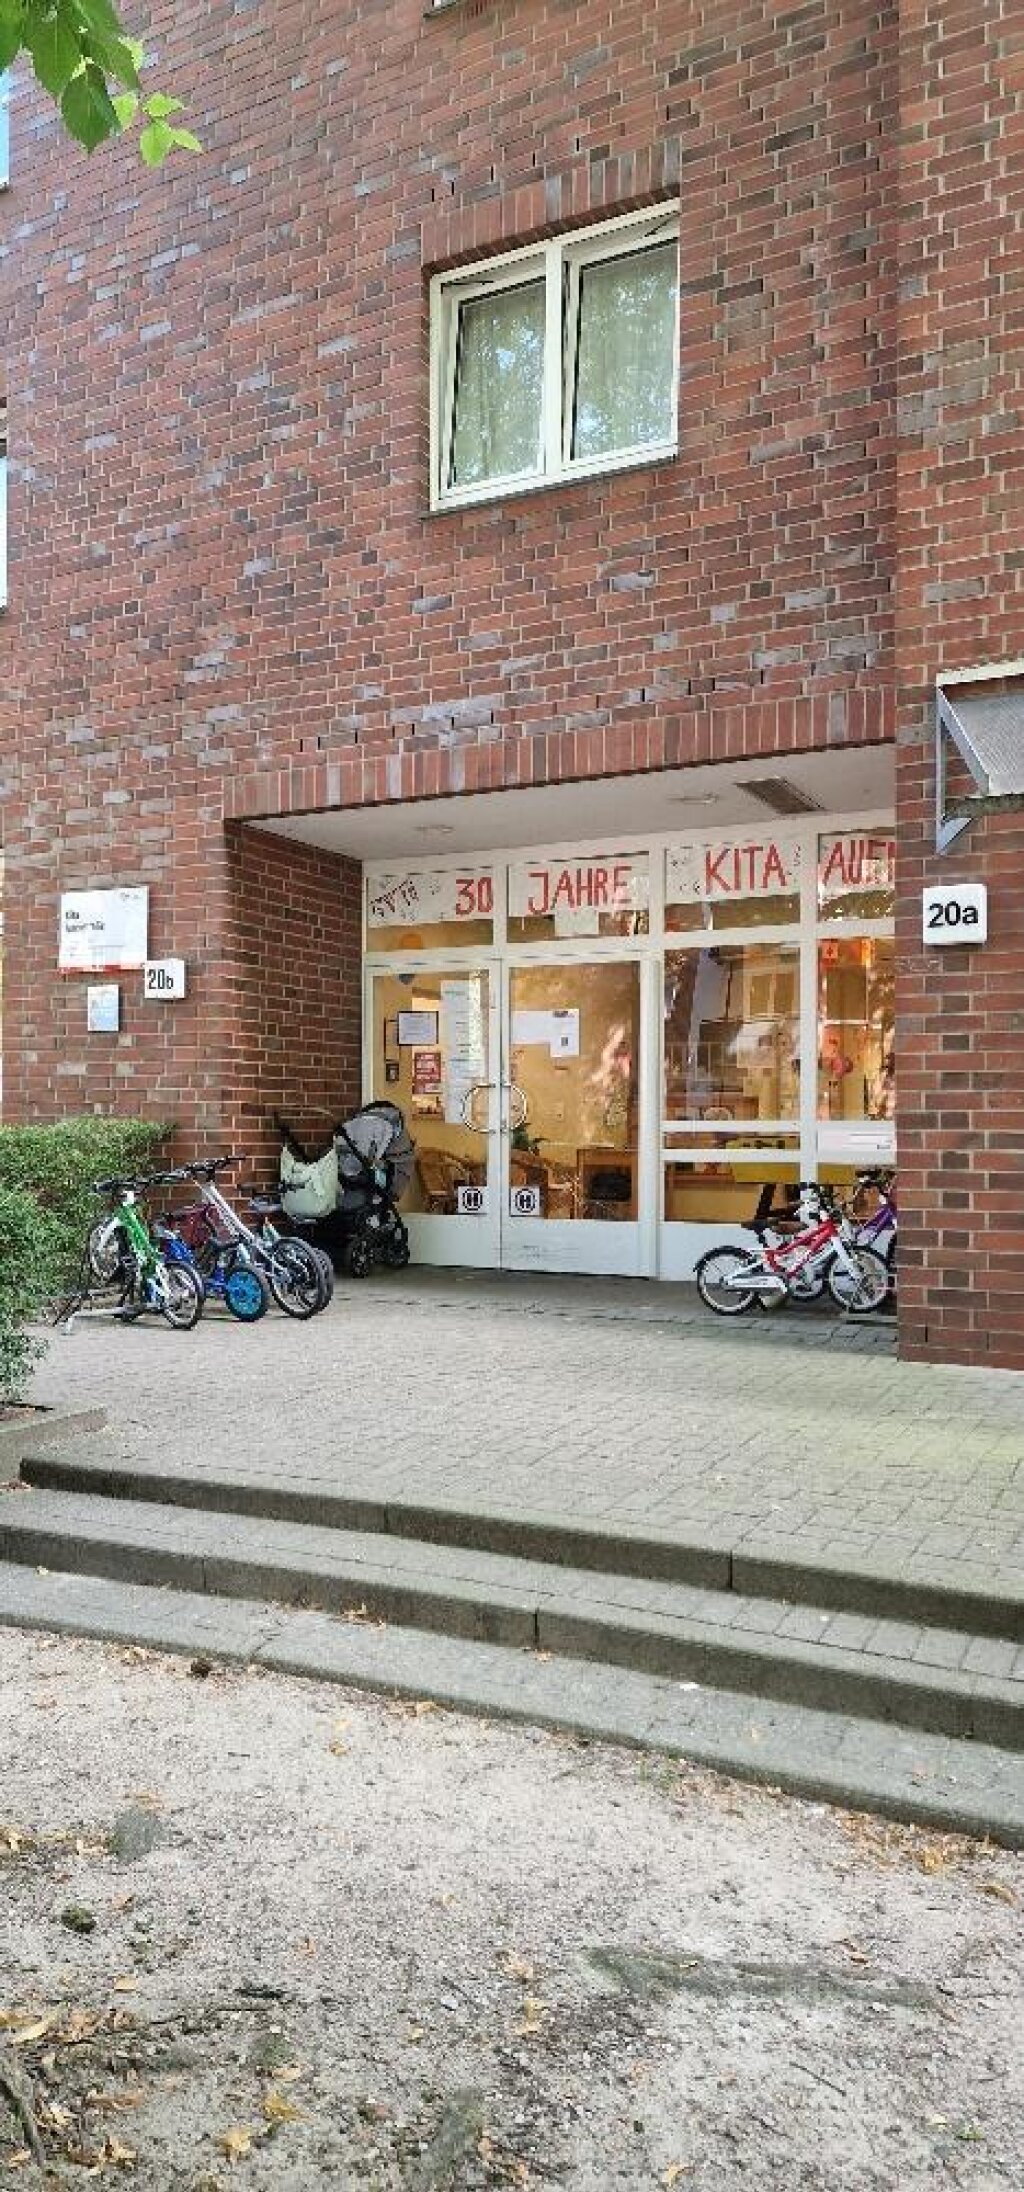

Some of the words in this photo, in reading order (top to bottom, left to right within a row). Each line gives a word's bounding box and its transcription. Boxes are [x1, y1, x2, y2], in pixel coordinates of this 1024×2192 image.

[455, 876, 494, 915] 30
[527, 865, 633, 916] JAHRE
[705, 843, 787, 895] KITA
[927, 900, 979, 928] 20a
[148, 968, 174, 990] 20b
